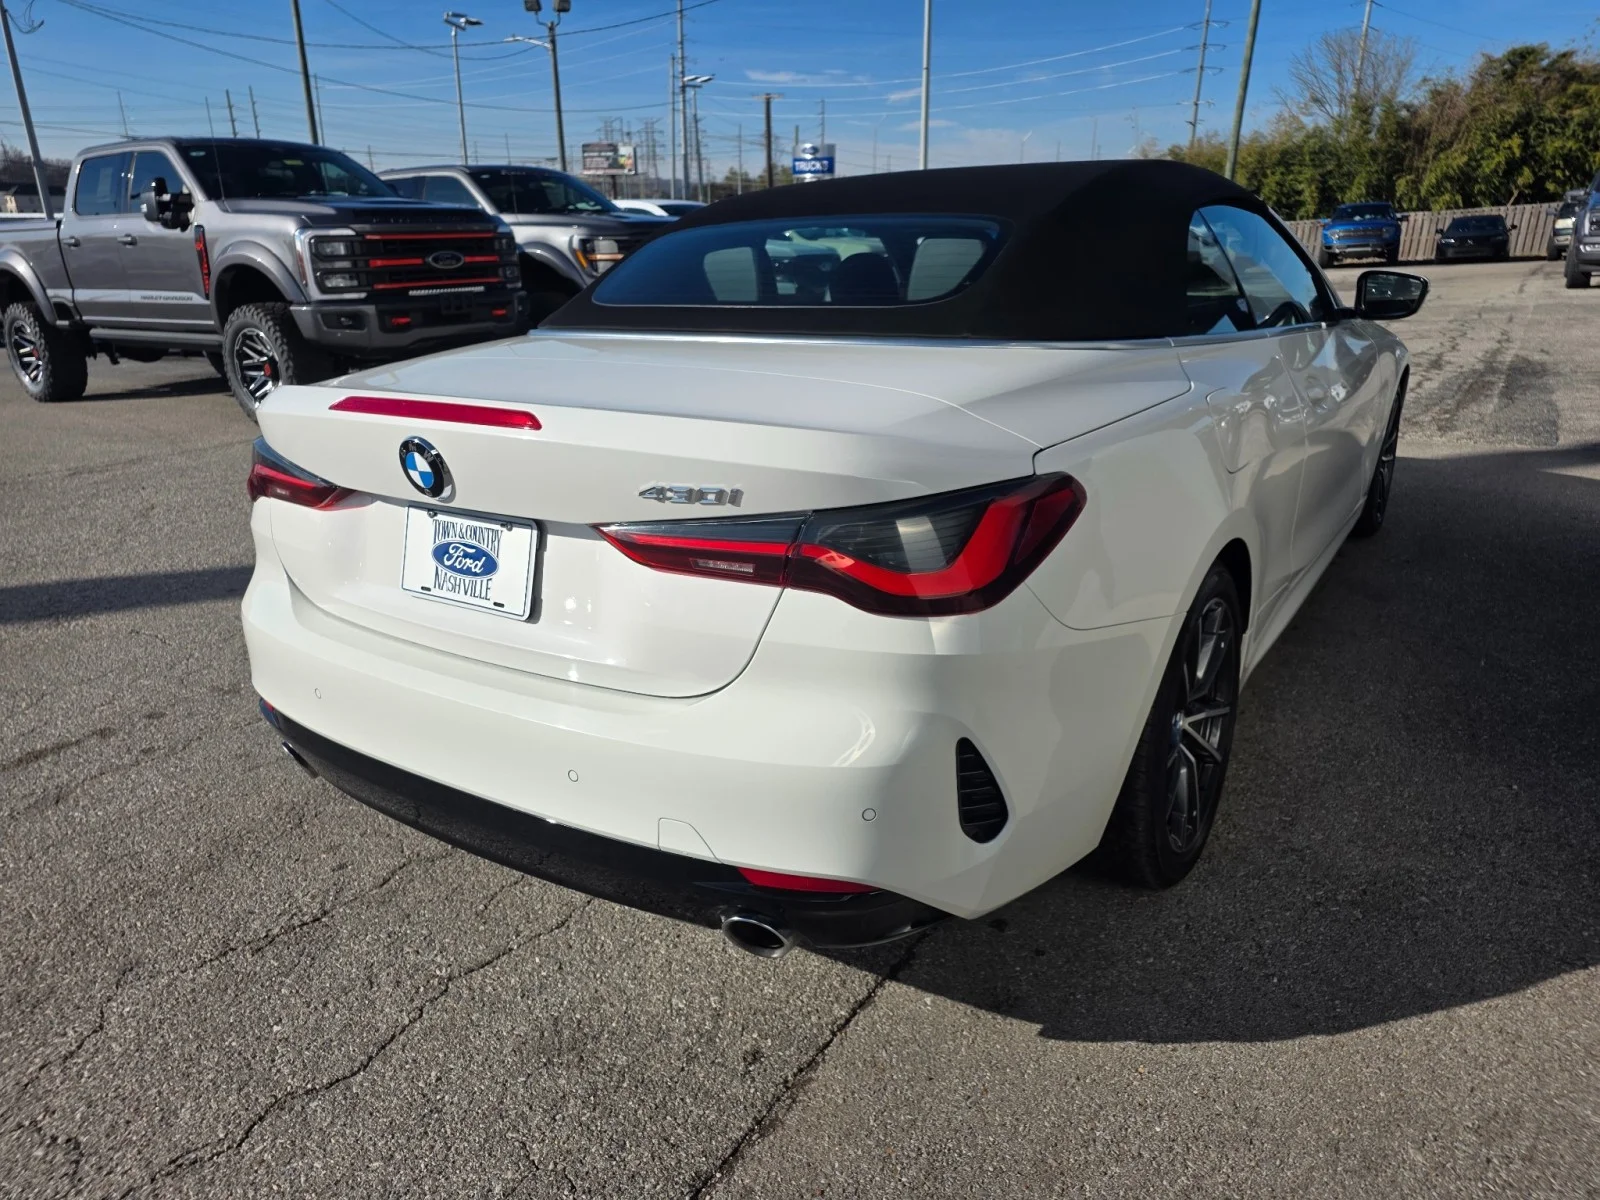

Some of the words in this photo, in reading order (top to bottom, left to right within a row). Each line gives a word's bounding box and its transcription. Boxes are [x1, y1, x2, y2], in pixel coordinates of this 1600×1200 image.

[794, 160, 829, 172] TRUCKS
[638, 484, 744, 507] 430i
[432, 518, 458, 545] TOWN
[459, 522, 466, 540] &
[465, 524, 503, 560] COUNTRY
[443, 543, 487, 573] Ford
[433, 565, 493, 601] NASHVILLE
